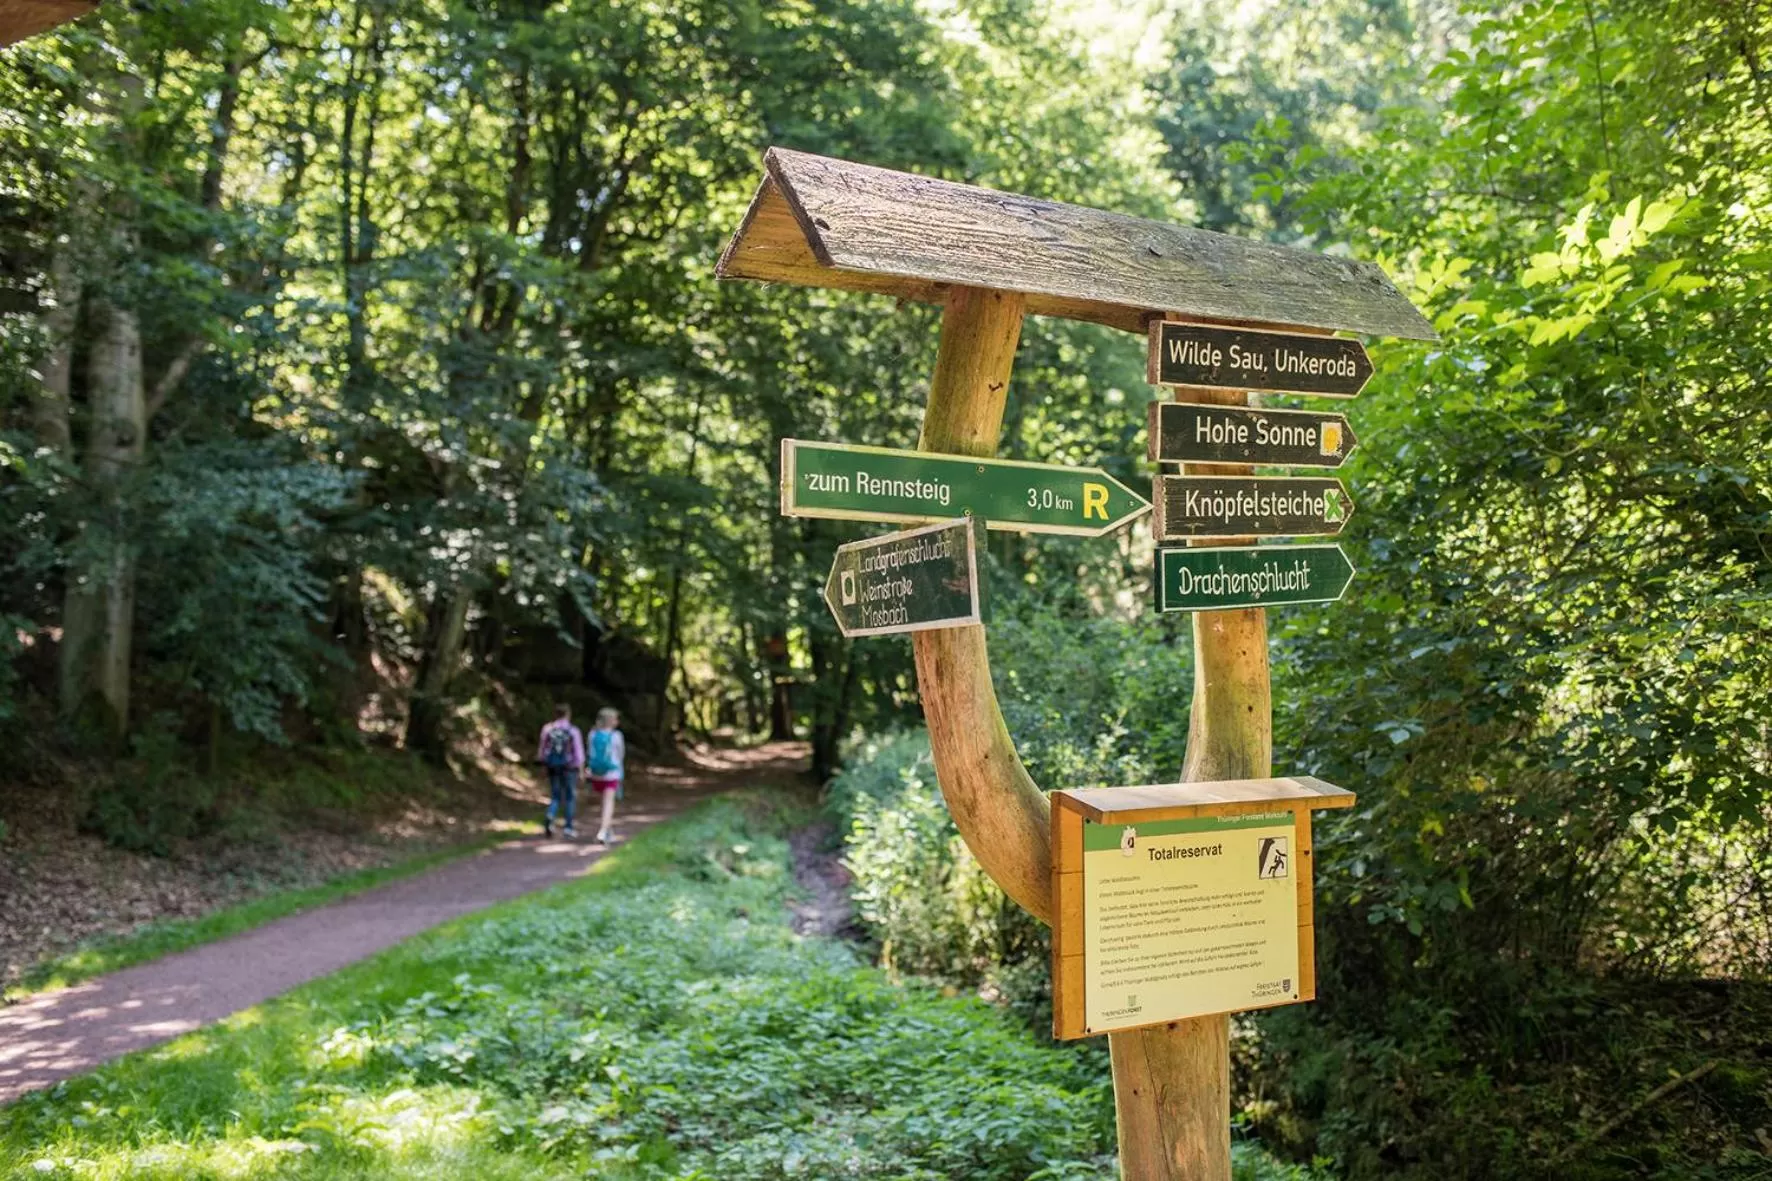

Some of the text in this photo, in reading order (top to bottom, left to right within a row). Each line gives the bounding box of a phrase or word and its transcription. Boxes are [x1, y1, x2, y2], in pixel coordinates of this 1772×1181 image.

[1168, 339, 1356, 377] Wilde Sau, Unkeroda
[1196, 416, 1317, 446] Hohe Sonne
[808, 471, 1110, 520] zum Rennsteig 3,0 km R
[1185, 489, 1324, 524] Knöpfelsteiche
[1178, 559, 1311, 596] Drachenschlucht
[1148, 842, 1223, 862] Totalreservat
